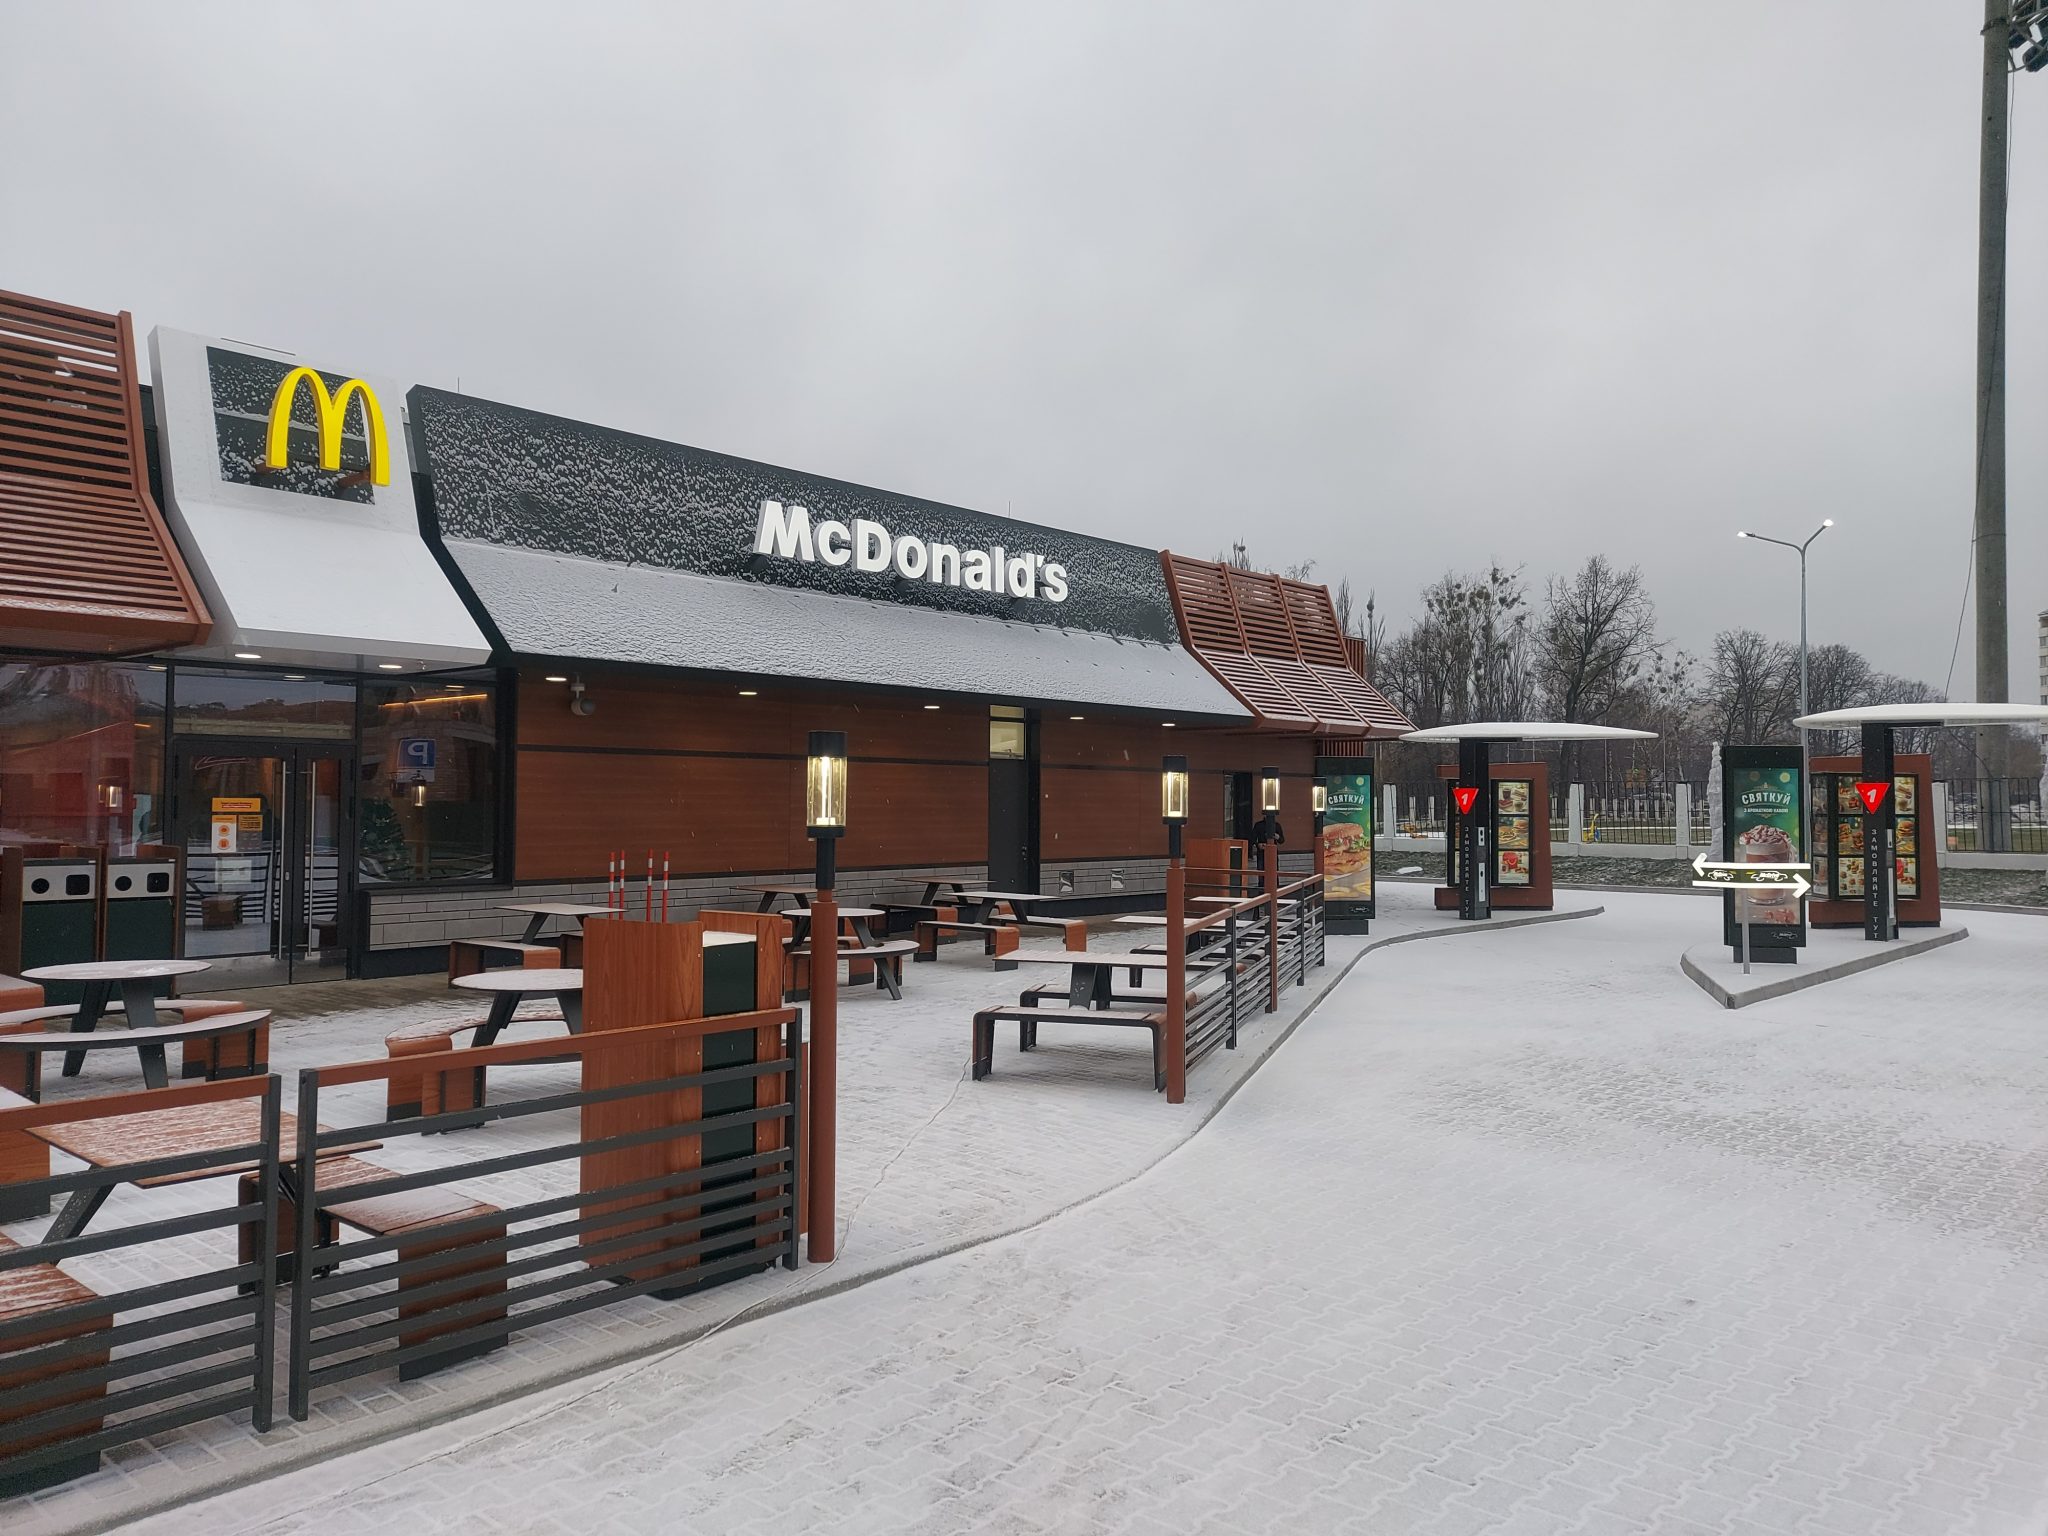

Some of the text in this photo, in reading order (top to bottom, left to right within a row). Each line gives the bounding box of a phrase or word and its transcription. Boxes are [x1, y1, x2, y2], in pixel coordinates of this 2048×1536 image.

[752, 500, 1069, 603] McDonald's
[1328, 794, 1365, 805] СВЯТКУЙ
[1461, 793, 1469, 805] 1
[1741, 792, 1791, 805] СВЯТКУЙ
[1866, 789, 1877, 803] 1
